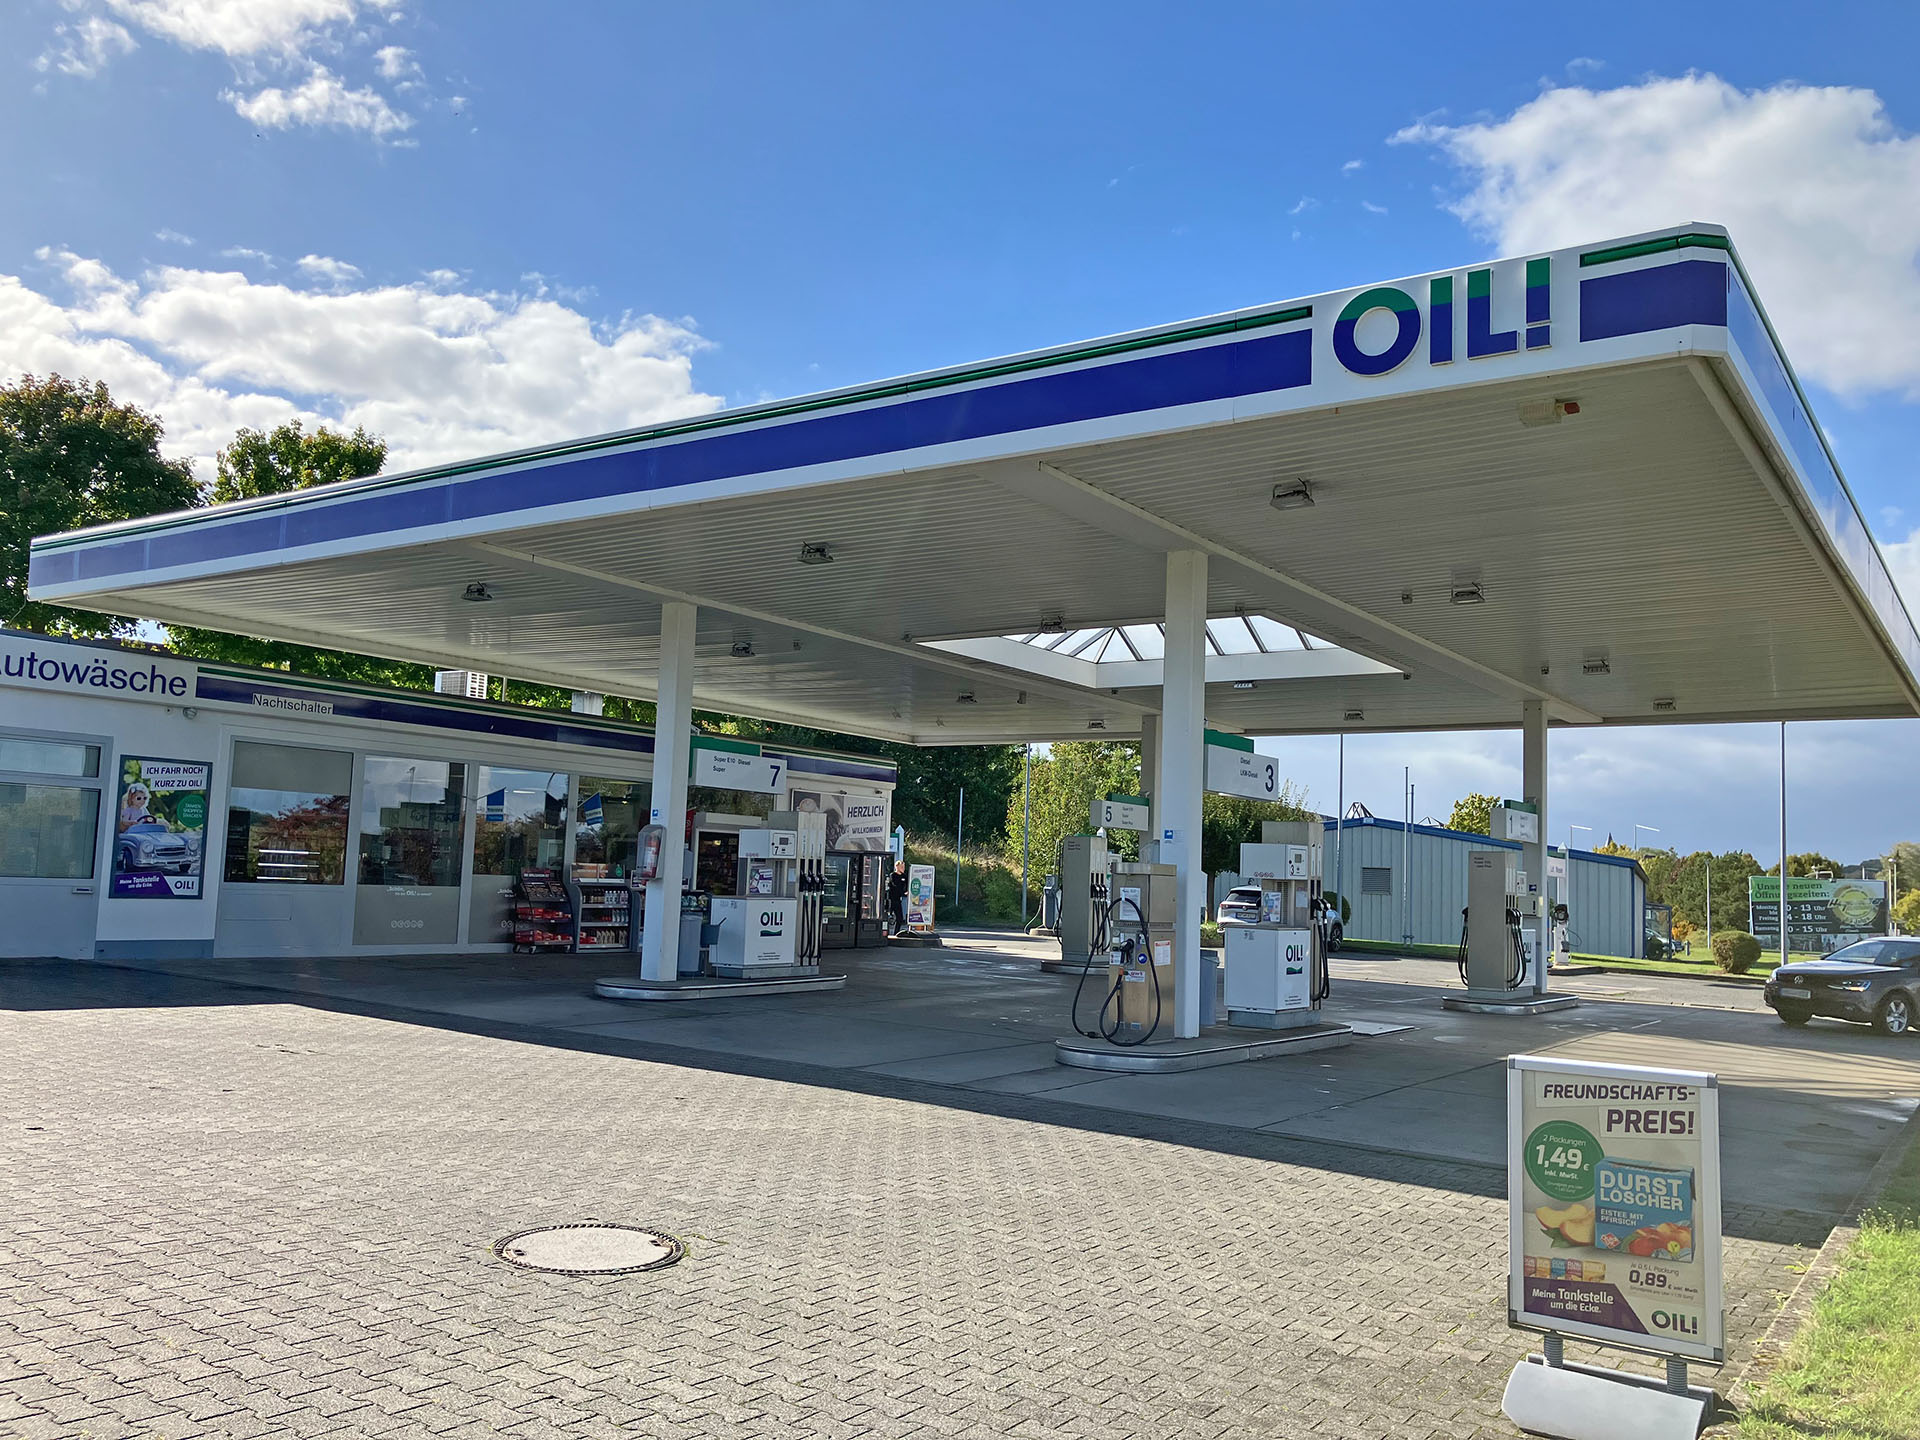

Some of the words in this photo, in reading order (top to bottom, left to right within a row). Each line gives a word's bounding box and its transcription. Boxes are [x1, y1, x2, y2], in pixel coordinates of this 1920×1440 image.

[1332, 257, 1552, 375] OIL!
[0, 652, 187, 696] utowäsche
[253, 694, 332, 714] Nachtschalter
[713, 755, 726, 763] Super
[712, 765, 726, 773] Super
[769, 764, 781, 787] 7
[1265, 764, 1274, 792] 3
[847, 805, 884, 818] HERZLICH
[1105, 806, 1112, 822] 5
[852, 826, 883, 834] WILLKOMMEN
[1509, 815, 1513, 834] 1
[774, 846, 779, 856] 7
[1290, 864, 1295, 876] 3
[174, 881, 194, 889] OIL!
[1754, 889, 1830, 899] Öffnugszeiten:
[1801, 904, 1811, 912] 13
[760, 911, 783, 926] OIL!
[1286, 944, 1303, 962] OIL!
[1543, 1084, 1695, 1101] FREUNDSCHAFTS-
[1606, 1109, 1695, 1135] PREIS!
[1549, 1135, 1586, 1147] Packungen
[1536, 1144, 1583, 1170] 1,49
[1583, 1163, 1590, 1171] €
[1559, 1171, 1579, 1180] MwSt.
[1600, 1170, 1683, 1197] DURST
[1600, 1187, 1684, 1211] LÖSCHER
[1600, 1208, 1628, 1219] EISTEE
[1630, 1211, 1644, 1220] MIT
[1600, 1215, 1637, 1227] PFIRSICH
[1629, 1269, 1667, 1288] 0,89
[1653, 1265, 1679, 1277] Packung
[1532, 1288, 1556, 1299] Meine
[1557, 1288, 1614, 1304] Tankstelle
[1550, 1301, 1564, 1310] um
[1565, 1301, 1578, 1311] die
[1580, 1302, 1601, 1313] Ecke.
[1651, 1310, 1698, 1335] OIL!
